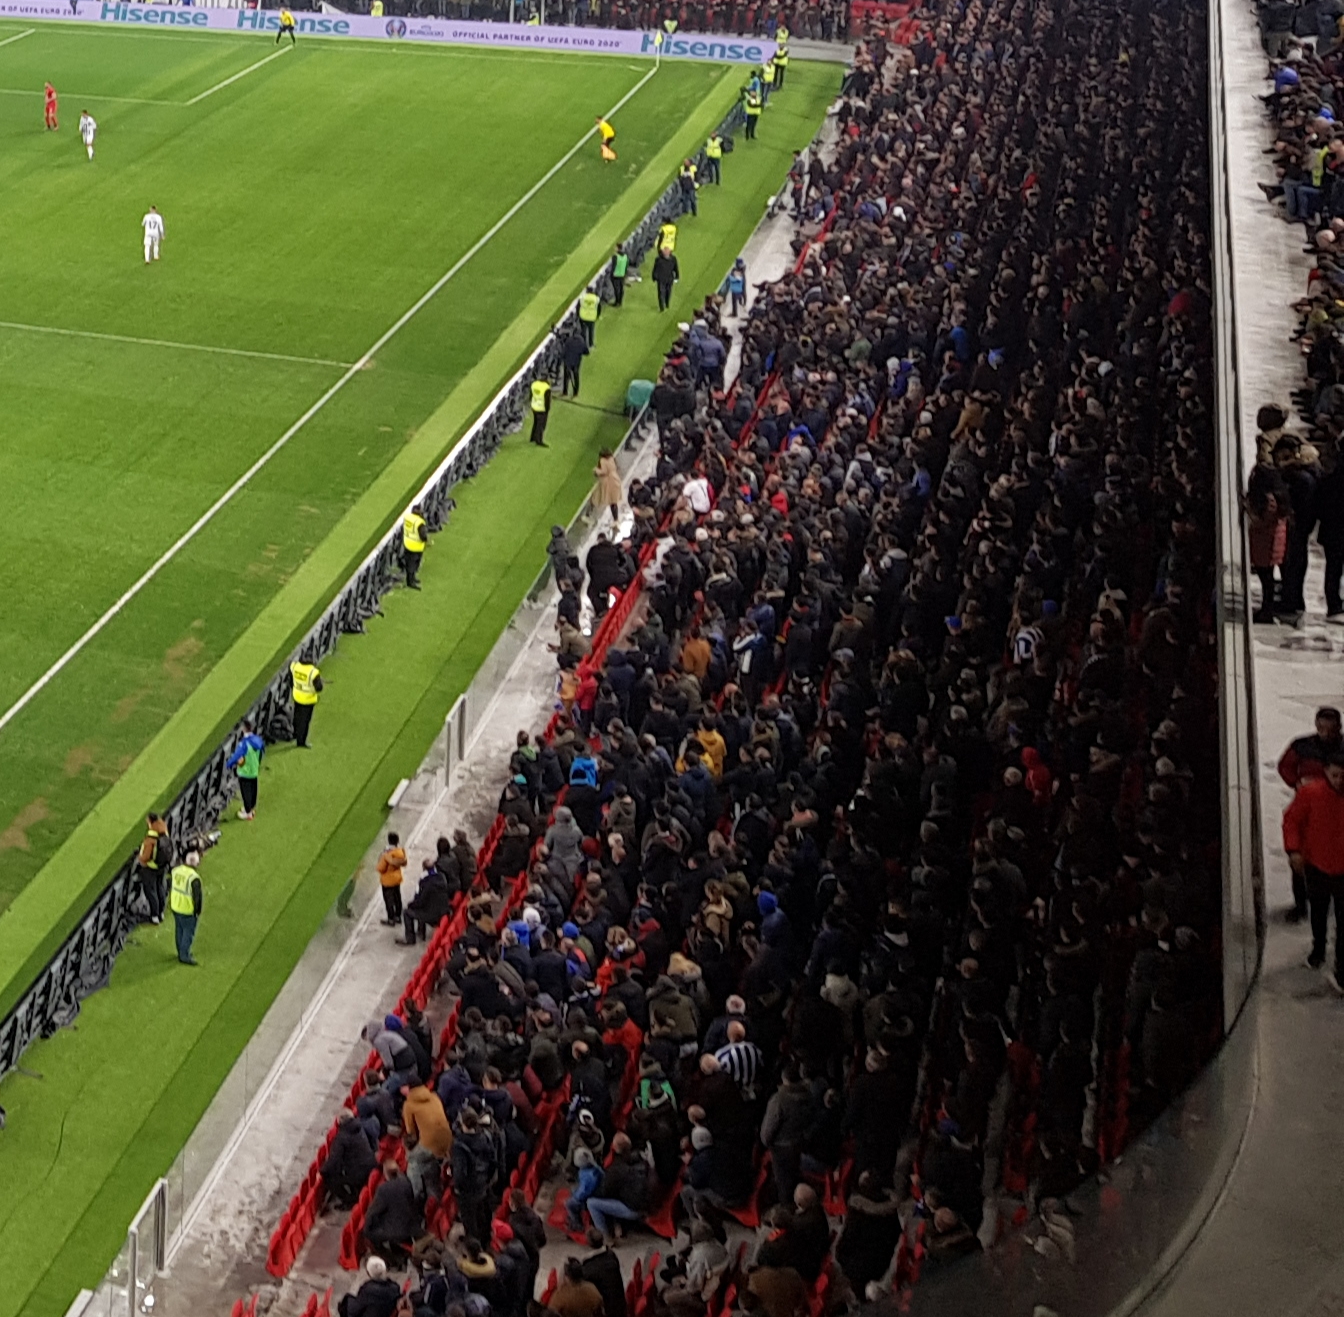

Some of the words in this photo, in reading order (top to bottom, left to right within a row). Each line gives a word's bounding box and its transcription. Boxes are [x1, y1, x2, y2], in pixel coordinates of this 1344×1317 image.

[100, 2, 208, 26] Hisense
[237, 10, 350, 34] Hisnse
[452, 30, 490, 40] OFFICIAL
[493, 33, 531, 42] PARTNER
[534, 35, 545, 43] OF
[548, 36, 569, 44] UEFA
[572, 38, 595, 46] EURO
[640, 33, 763, 62] Hisense
